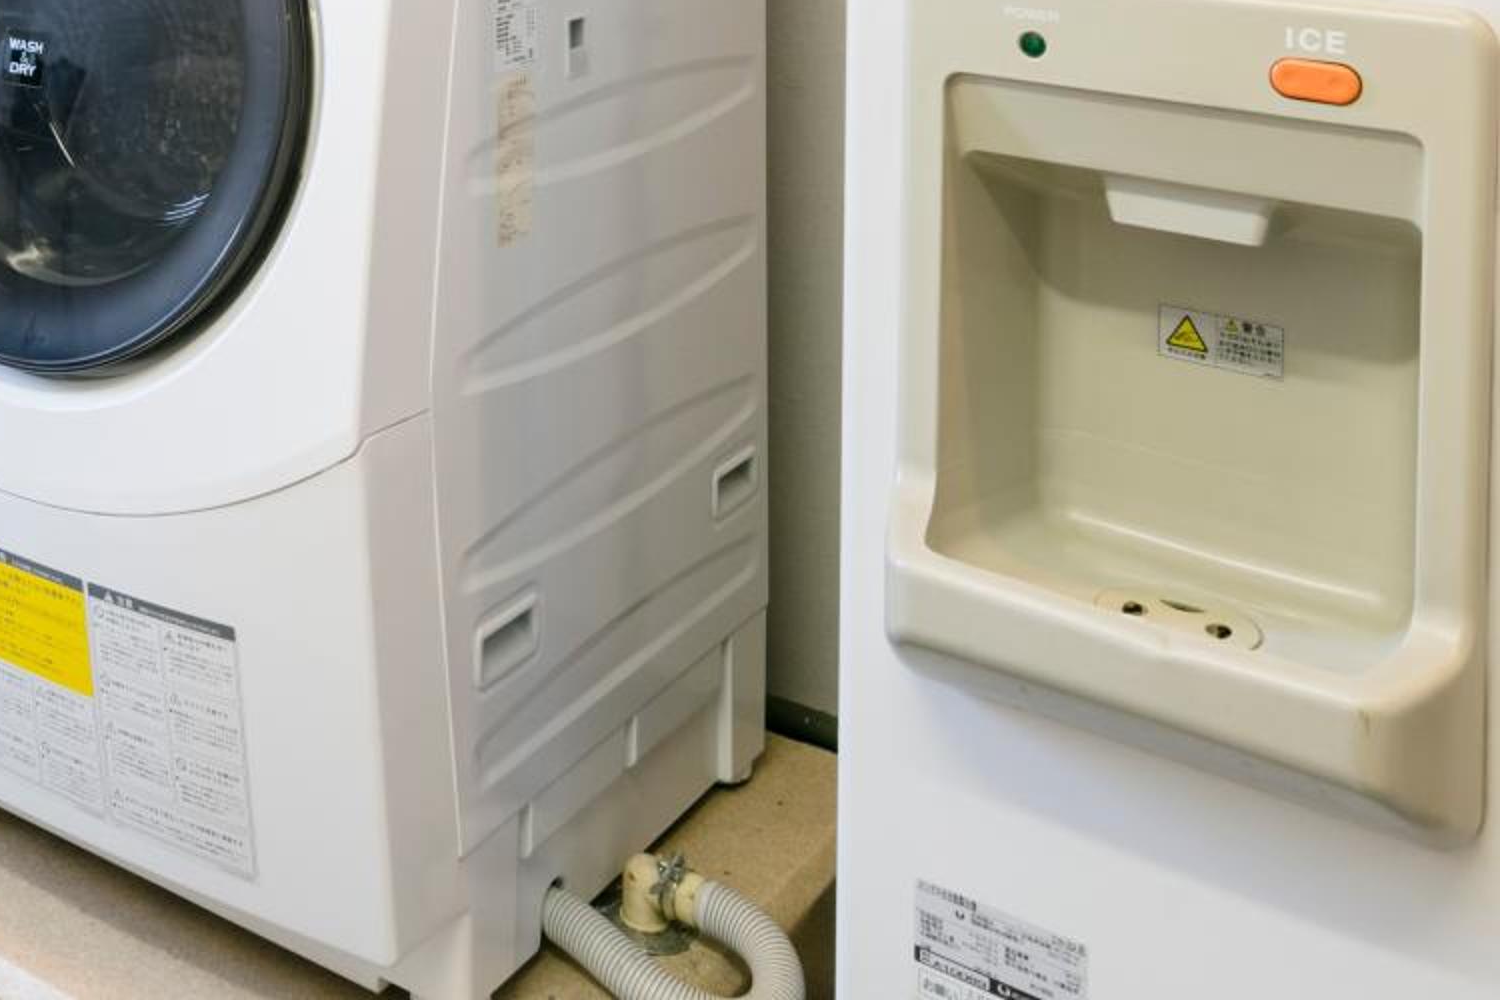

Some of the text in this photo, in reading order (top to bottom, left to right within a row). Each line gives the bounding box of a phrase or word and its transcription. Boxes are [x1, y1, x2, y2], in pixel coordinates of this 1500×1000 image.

[9, 37, 44, 55] WASH
[1284, 26, 1348, 56] ICE
[9, 61, 37, 77] DRY
